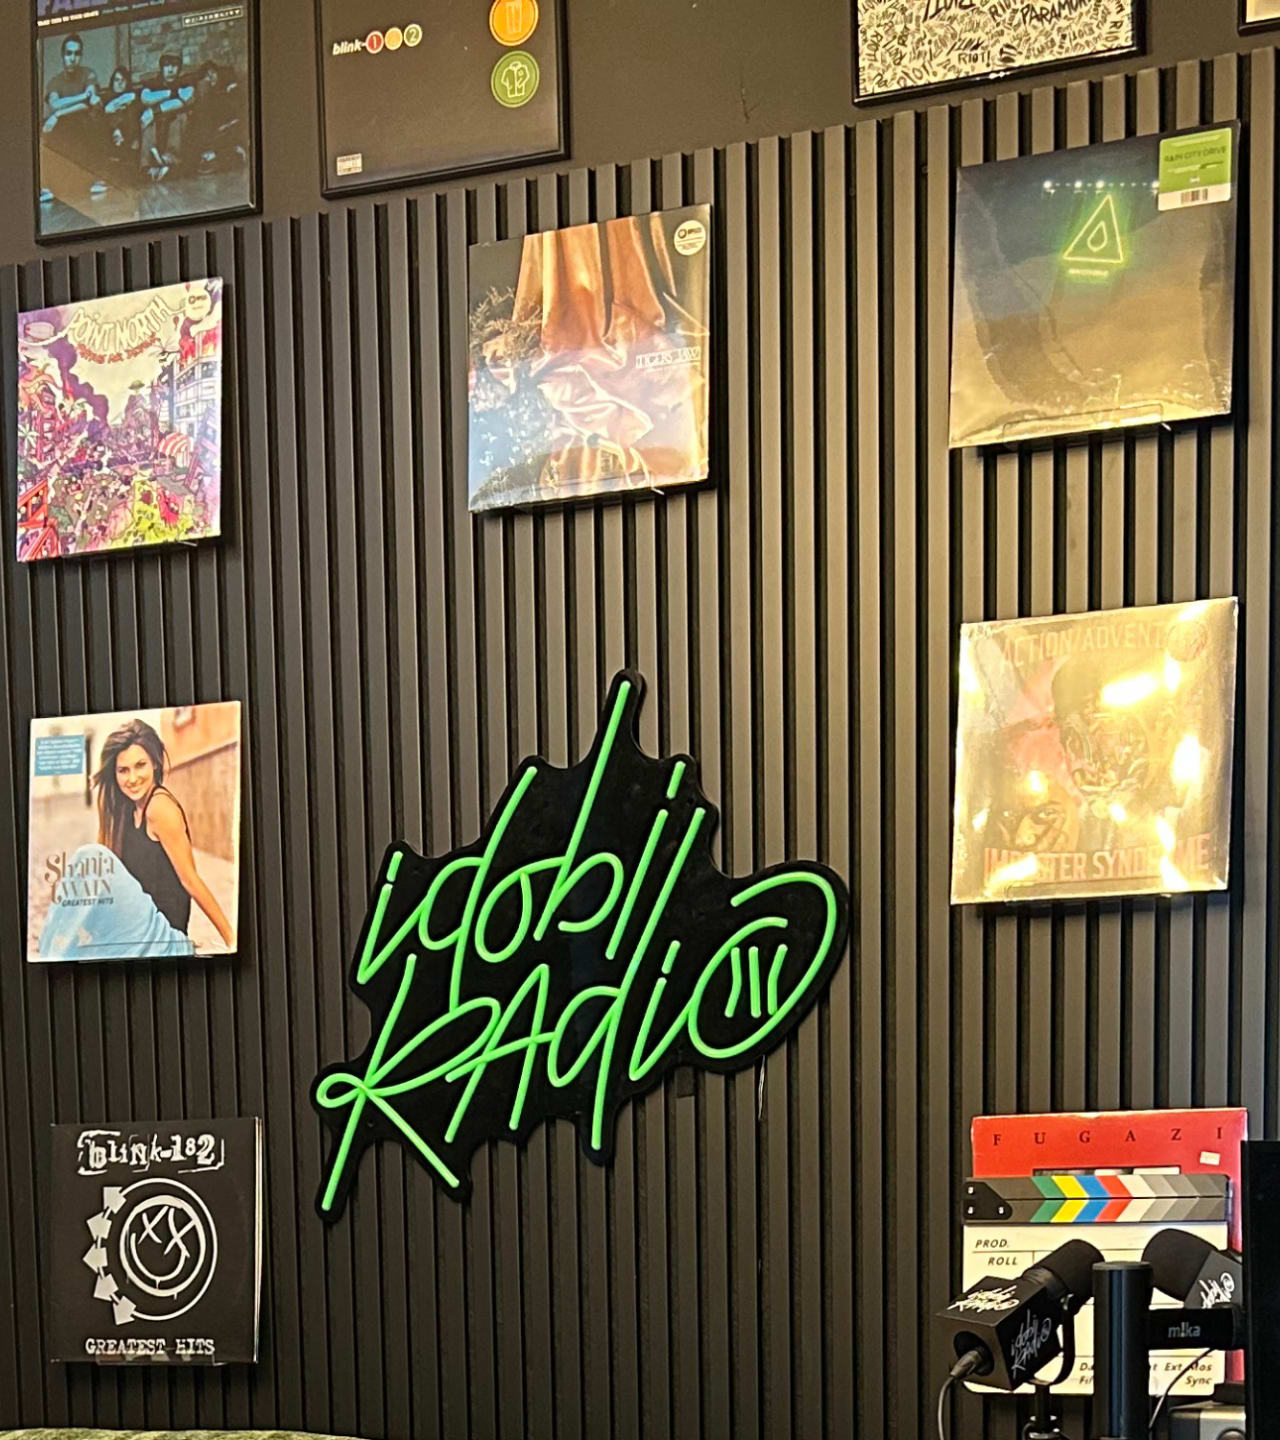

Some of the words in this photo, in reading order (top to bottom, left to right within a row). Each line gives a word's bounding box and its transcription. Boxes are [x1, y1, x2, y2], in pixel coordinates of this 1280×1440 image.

[332, 24, 423, 55] blink-12
[1003, 620, 1170, 668] ACTION/ADVENT
[45, 851, 115, 883] Shania
[988, 1256, 1018, 1266] ROLL
[85, 1338, 166, 1355] GREATEST
[175, 1338, 216, 1356] HITS
[1164, 1362, 1183, 1372] Ext
[1185, 1375, 1212, 1387] Sync
